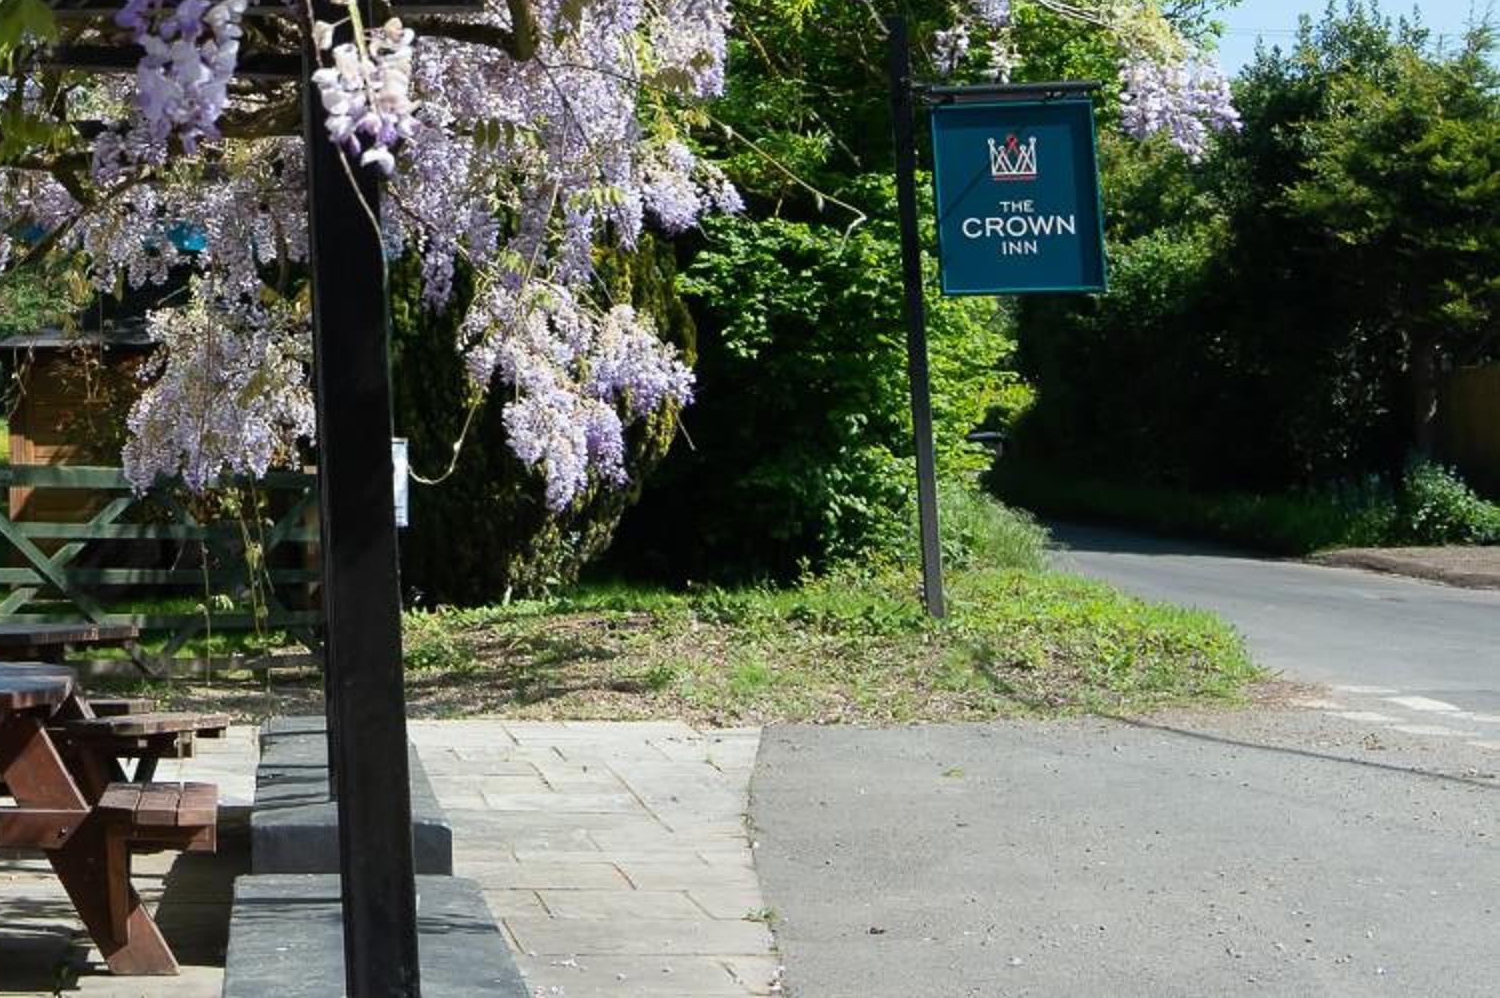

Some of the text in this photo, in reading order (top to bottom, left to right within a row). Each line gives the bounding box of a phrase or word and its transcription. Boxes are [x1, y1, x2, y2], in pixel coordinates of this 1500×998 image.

[999, 200, 1035, 213] THE
[962, 215, 1076, 238] CROWN
[1002, 241, 1038, 255] INN
